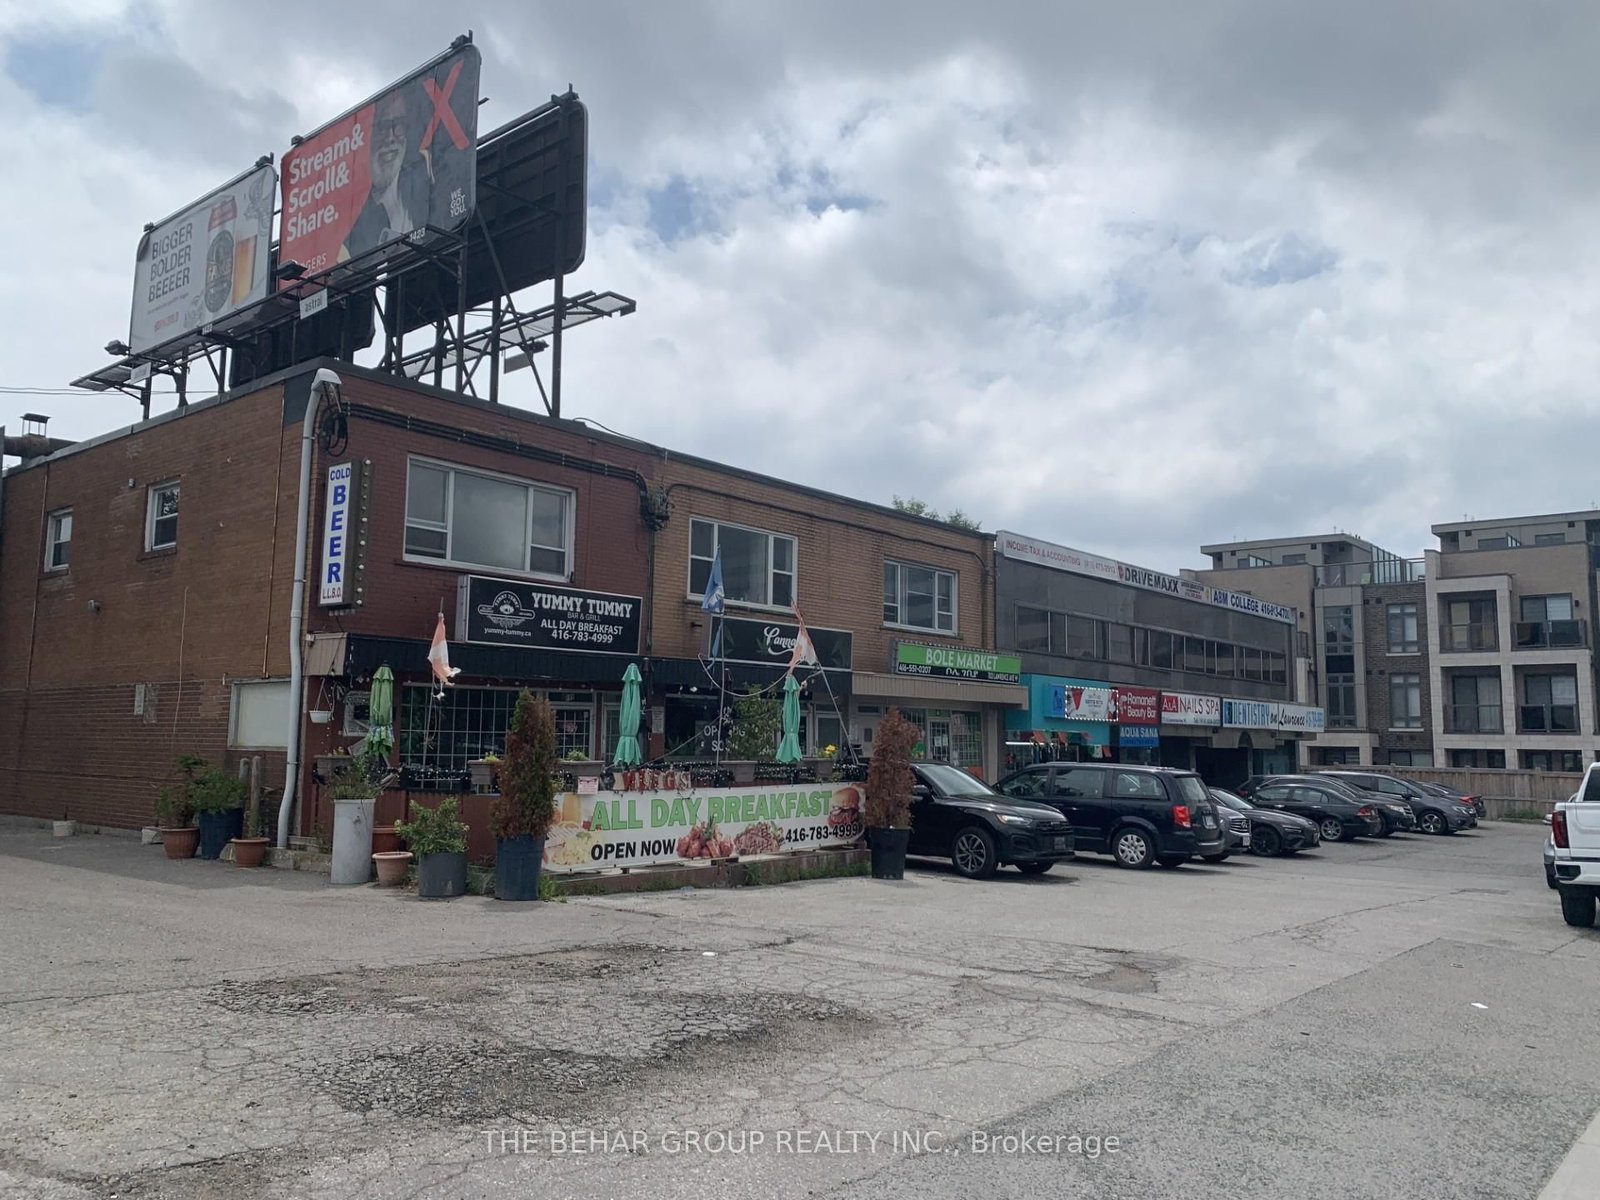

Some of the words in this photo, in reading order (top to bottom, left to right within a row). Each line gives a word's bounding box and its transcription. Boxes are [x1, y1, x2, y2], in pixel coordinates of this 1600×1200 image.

[289, 123, 364, 184] Stream&
[288, 161, 349, 213] Scroll&
[450, 188, 462, 201] WE
[450, 194, 466, 209] GOT
[287, 204, 339, 243] Share.
[151, 222, 193, 260] BIGGER
[150, 245, 191, 282] BOLDER
[149, 267, 190, 303] BEEEER
[330, 467, 350, 481] COLD
[327, 484, 346, 584] BEER
[1124, 567, 1179, 594] DRIVEMAXX
[532, 592, 584, 612] YUMMY
[586, 599, 633, 618] TUMMY
[1230, 595, 1259, 613] COLLEGE
[540, 618, 558, 629] ALL
[559, 620, 577, 630] DAY
[578, 622, 623, 636] BREAKFAST
[567, 612, 579, 620] BAR
[585, 614, 601, 622] GRILL
[551, 630, 613, 644] 416-783-4999
[925, 648, 954, 666] BOLE
[956, 652, 998, 671] MARKET
[1127, 705, 1146, 720] Beauty
[1147, 707, 1156, 718] Bar
[1180, 696, 1204, 715] NAILS
[1206, 699, 1219, 715] SPA
[1233, 702, 1270, 727] DENTISTRY
[1120, 727, 1140, 738] AQUA
[1140, 727, 1159, 738] SANA
[589, 800, 643, 832] ALL
[651, 797, 702, 828] DAY
[707, 790, 833, 824] BREAKFAST
[785, 824, 859, 843] 416-783-4999
[591, 842, 637, 861] OPEN
[640, 838, 676, 857] NOW
